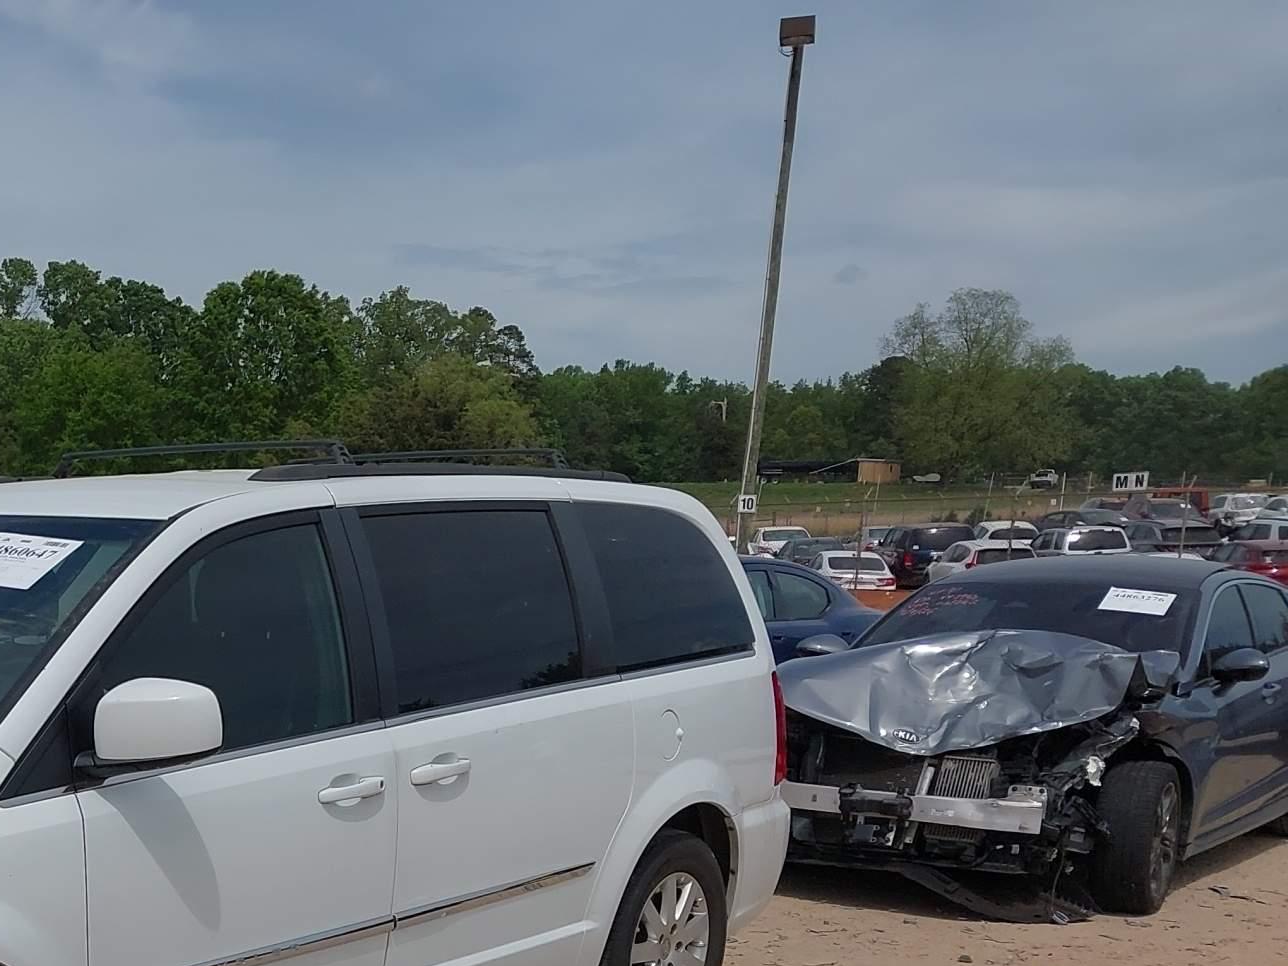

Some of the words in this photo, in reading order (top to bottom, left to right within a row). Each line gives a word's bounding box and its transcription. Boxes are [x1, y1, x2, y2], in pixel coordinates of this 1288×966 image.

[1115, 475, 1128, 488] M
[1135, 474, 1145, 488] N
[741, 497, 754, 510] 10
[898, 730, 917, 742] KIA
